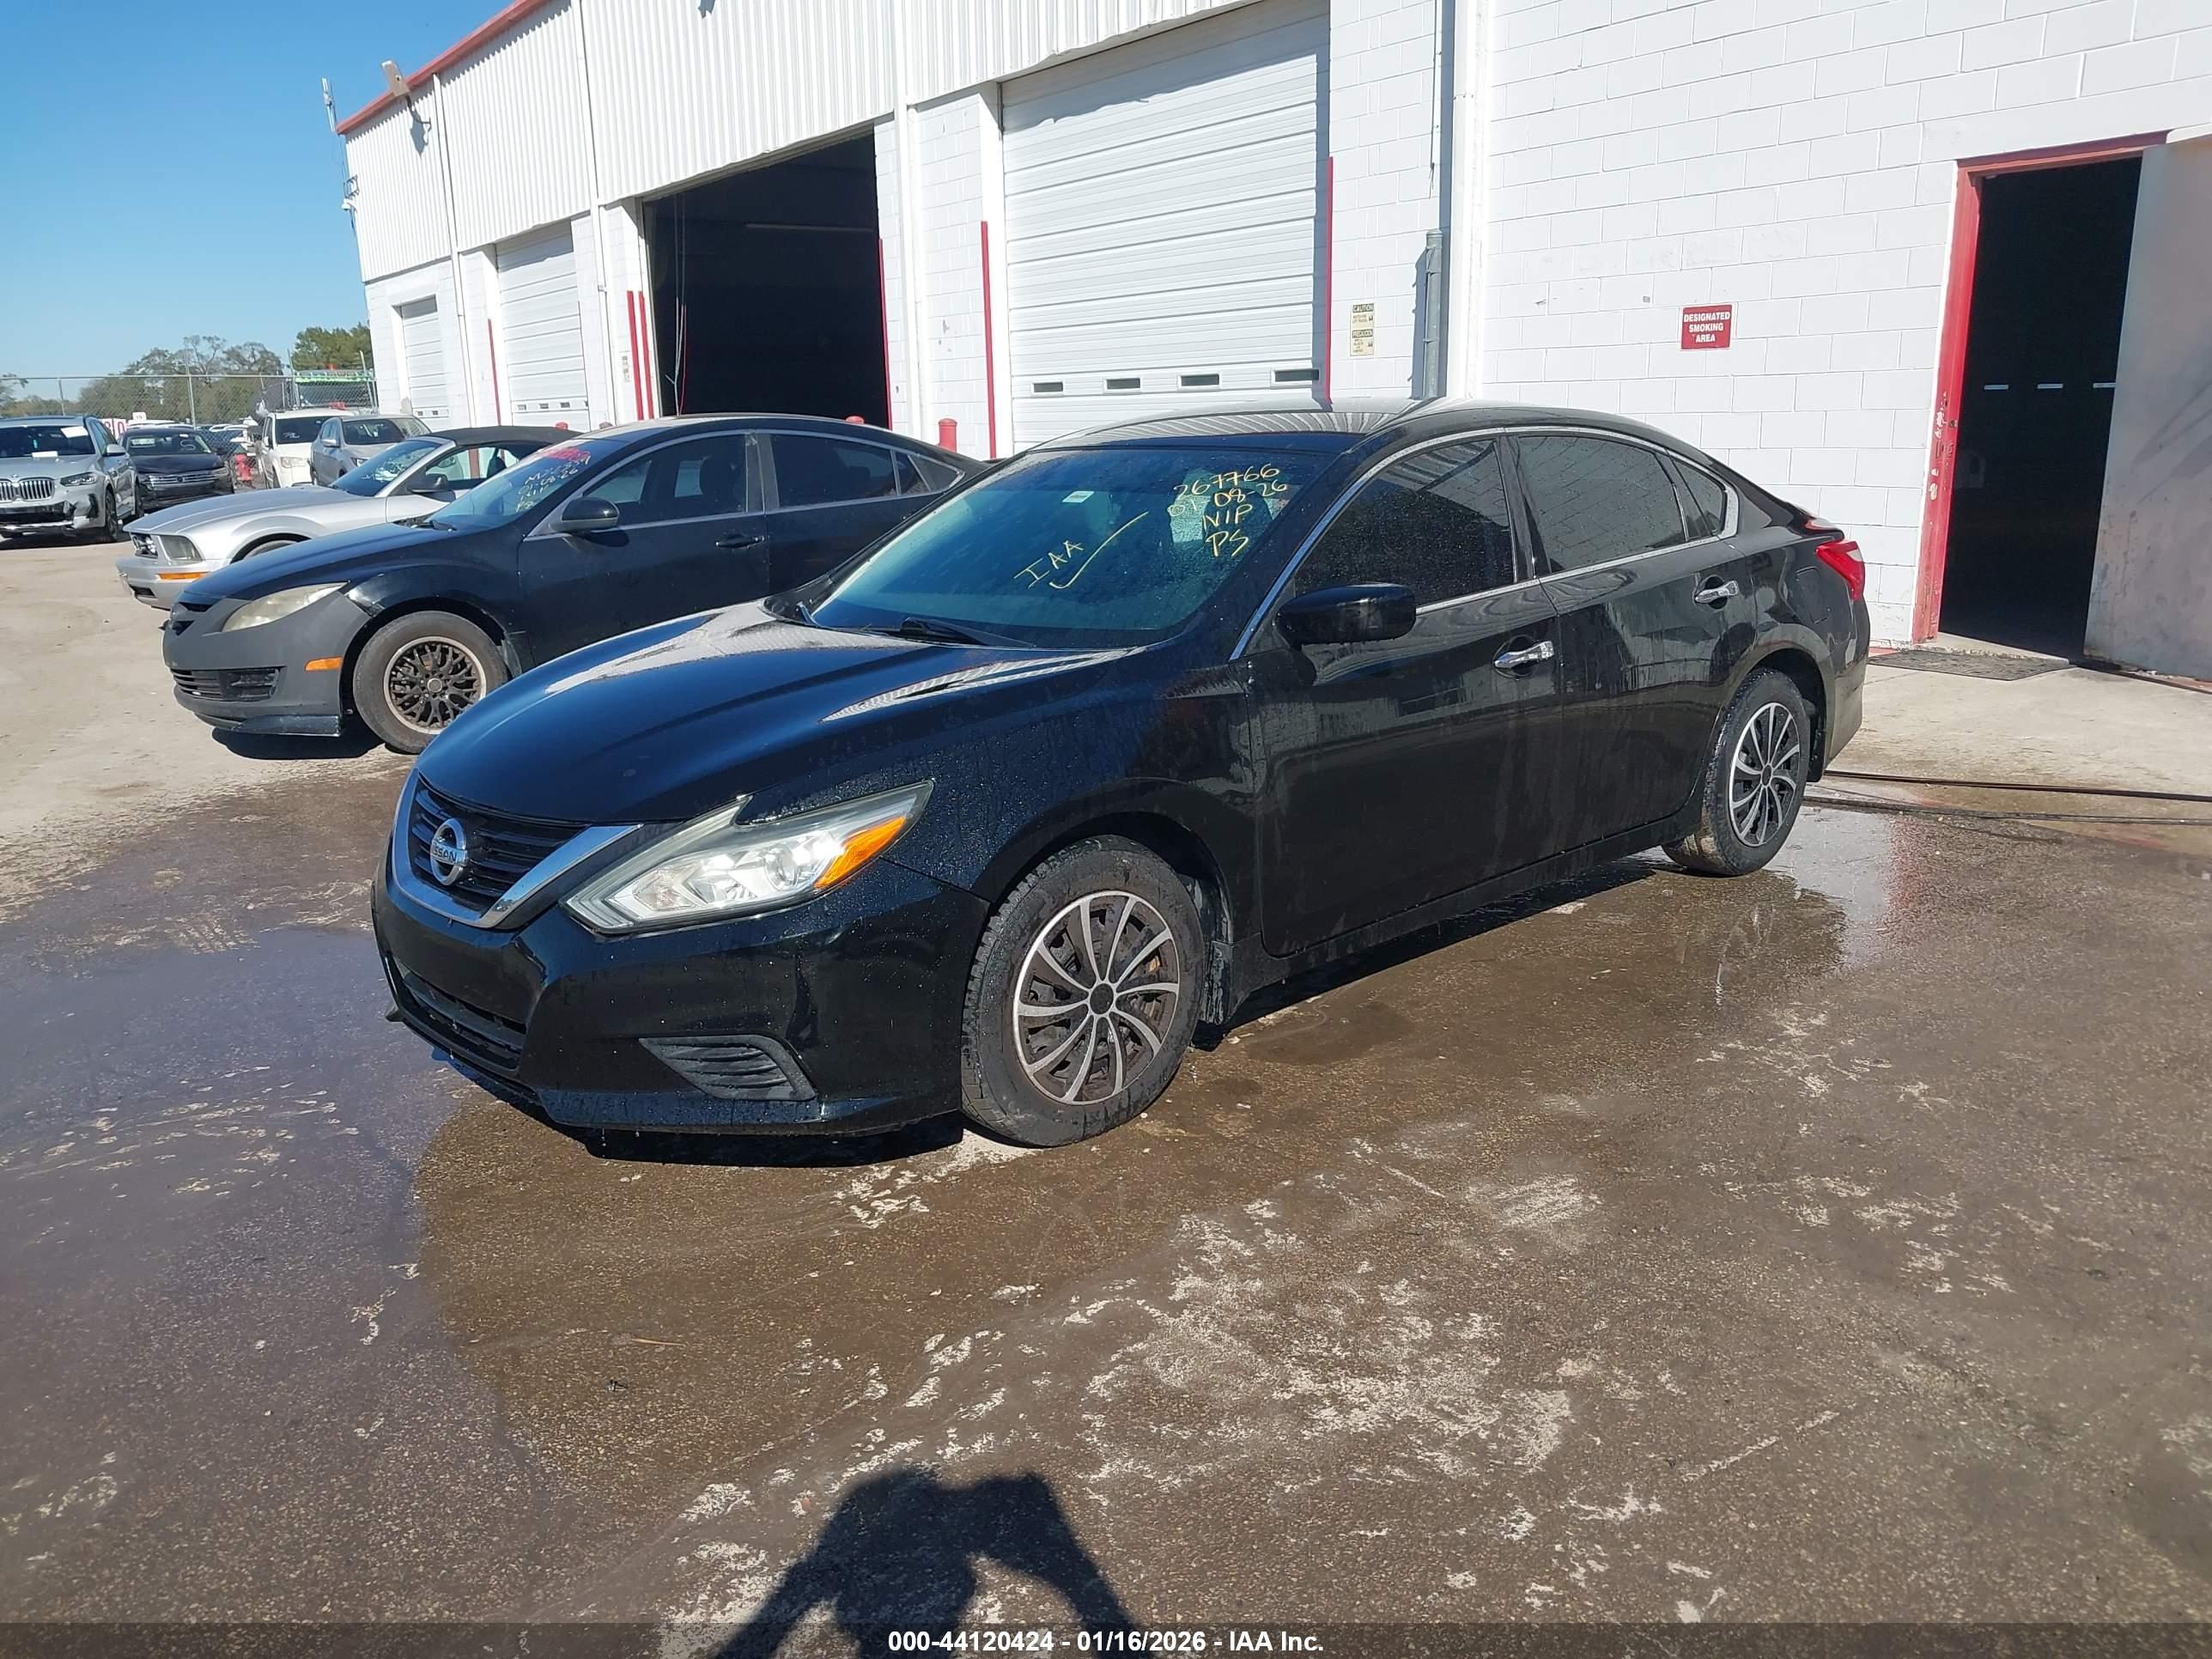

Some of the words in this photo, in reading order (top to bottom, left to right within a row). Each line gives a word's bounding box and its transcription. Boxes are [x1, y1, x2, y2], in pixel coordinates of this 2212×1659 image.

[1684, 312, 1730, 322] DESIGNATED
[1688, 323, 1724, 332] SMOKING
[1695, 334, 1716, 343] AREA
[1173, 464, 1280, 500] 267766
[1203, 503, 1253, 531] NIP
[1013, 540, 1085, 588] IAA
